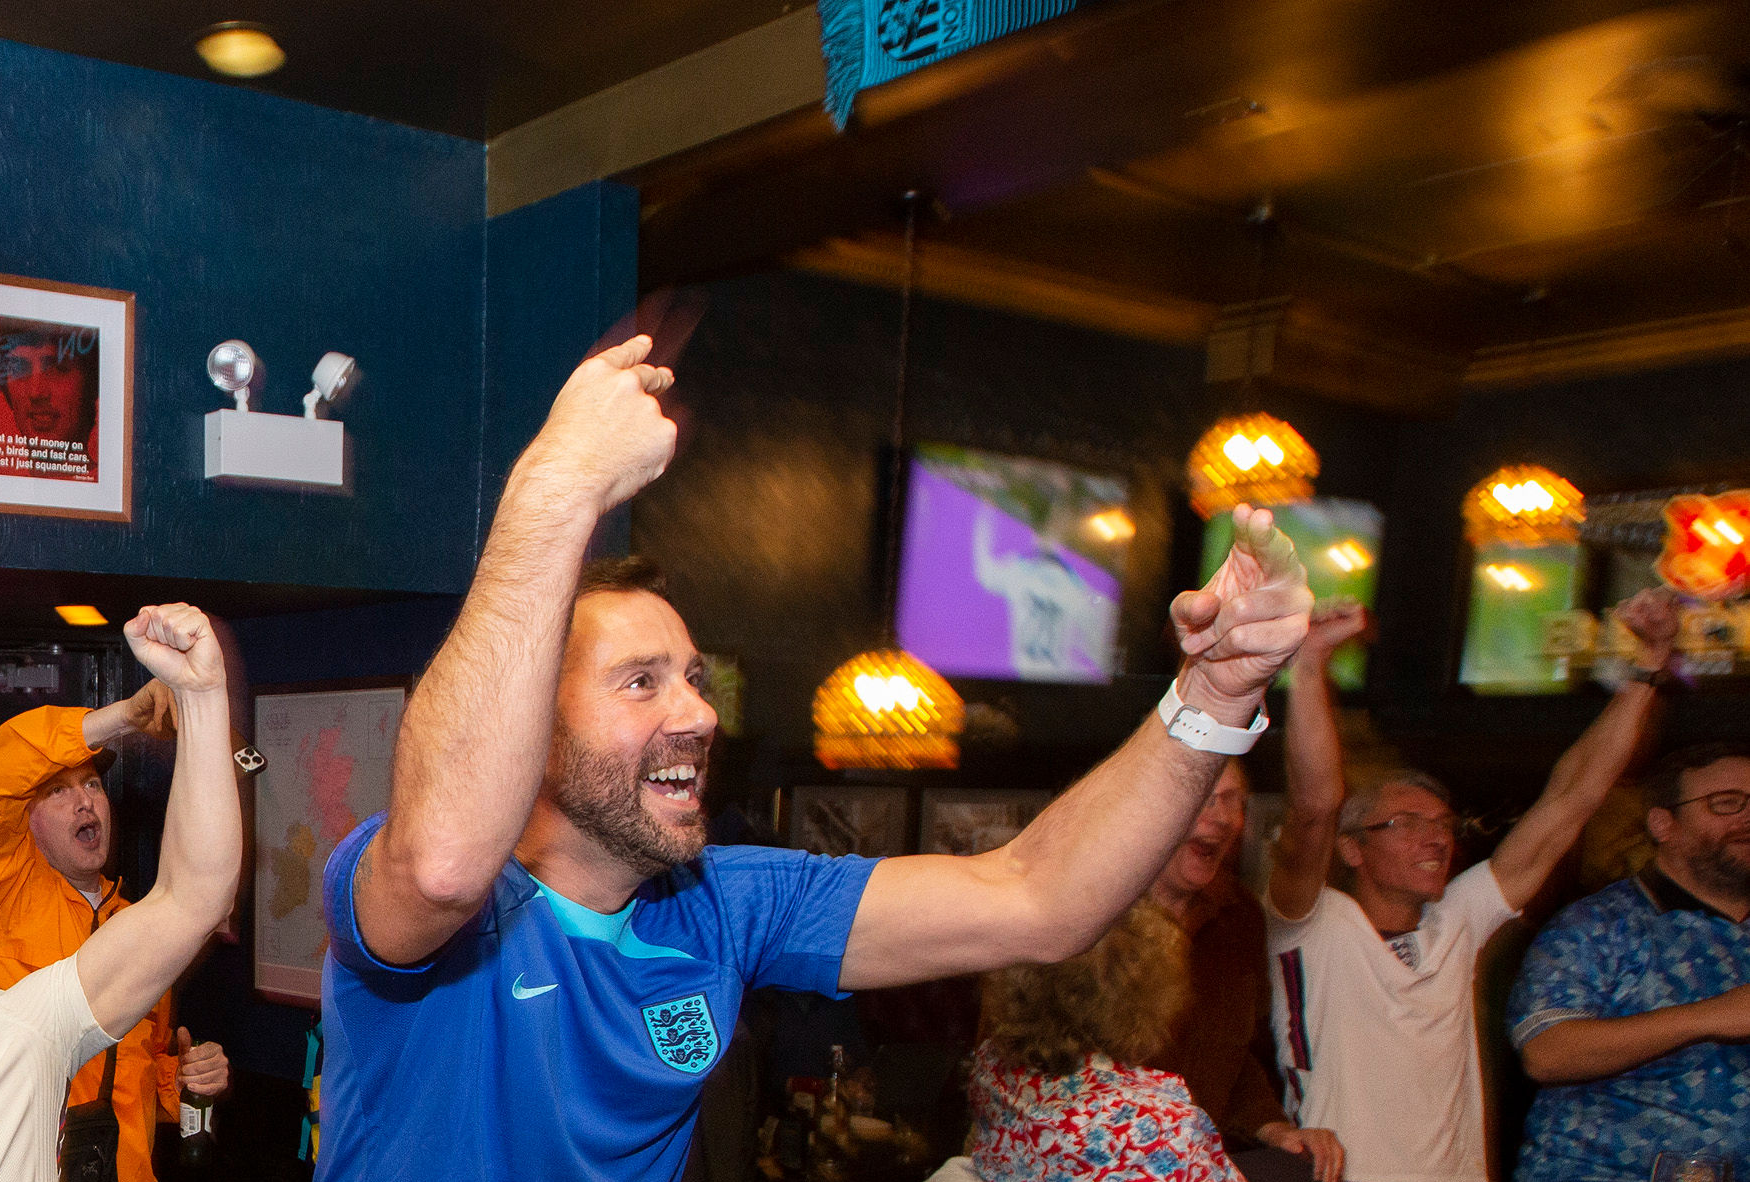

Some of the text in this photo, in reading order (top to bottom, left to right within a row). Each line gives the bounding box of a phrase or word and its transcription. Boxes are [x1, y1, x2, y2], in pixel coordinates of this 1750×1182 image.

[7, 435, 13, 443] a
[15, 434, 27, 445] lot
[29, 436, 39, 445] of
[40, 438, 70, 451] money
[72, 442, 84, 450] on
[6, 445, 30, 457] birds
[31, 448, 48, 458] and
[50, 449, 67, 460] fast
[68, 452, 90, 462] cars.
[15, 458, 33, 470] just
[35, 460, 89, 474] squandered.
